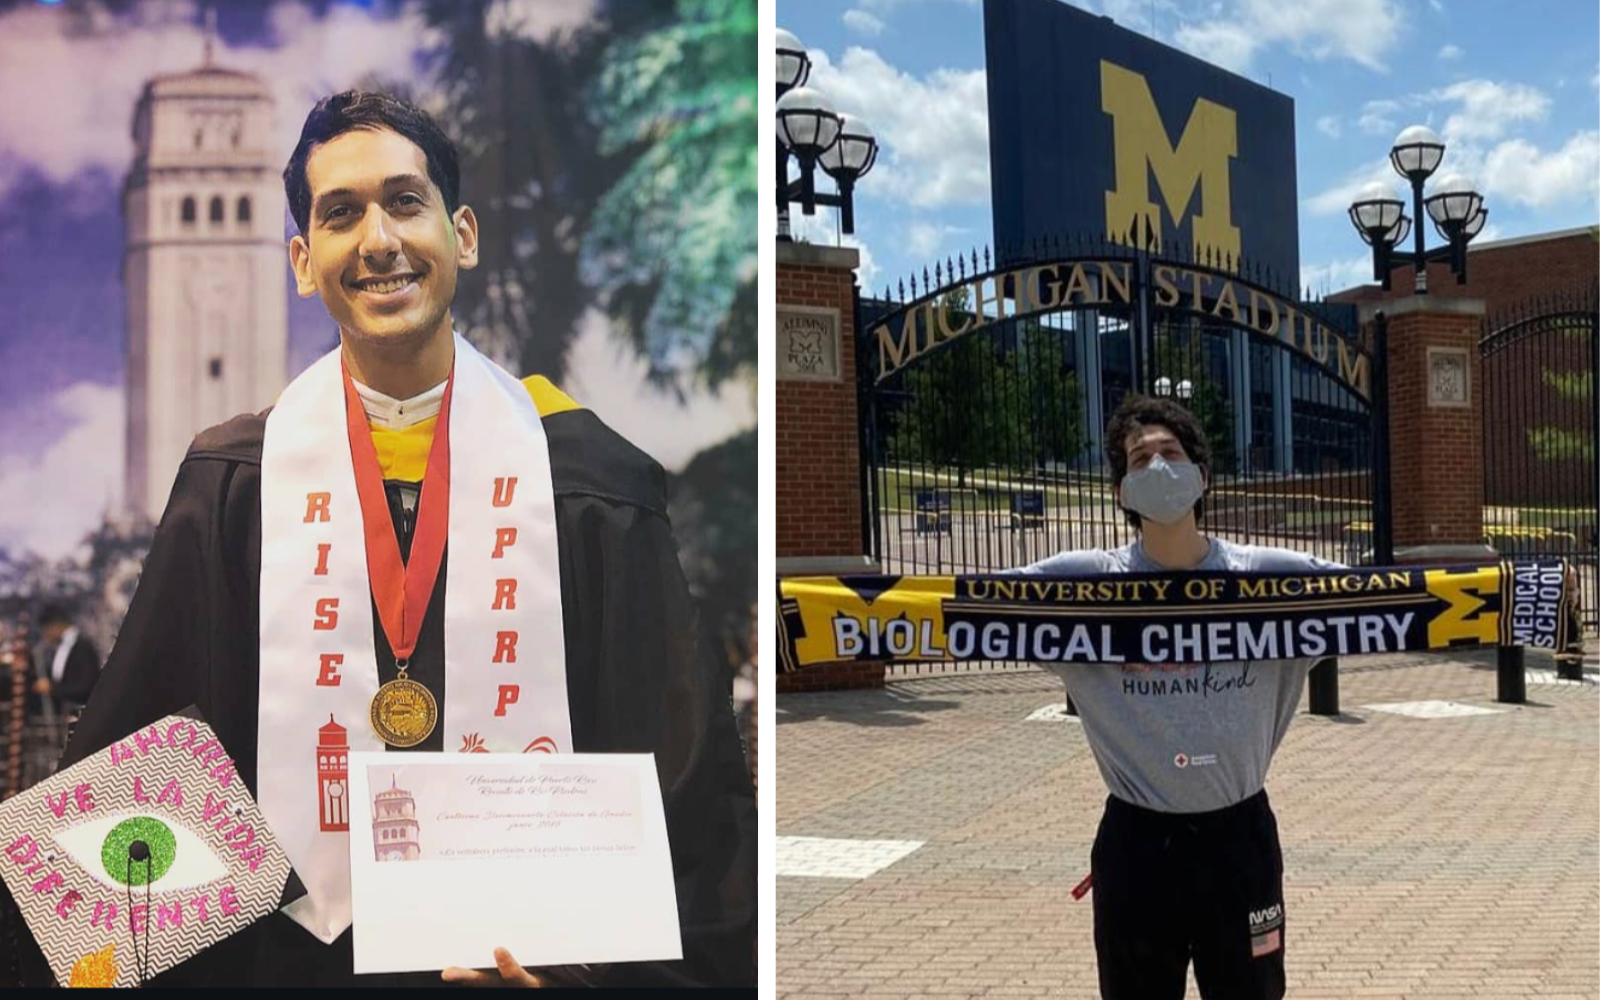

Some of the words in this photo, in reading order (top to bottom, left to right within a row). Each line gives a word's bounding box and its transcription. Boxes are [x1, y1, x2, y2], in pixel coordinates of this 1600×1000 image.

[1099, 58, 1242, 275] M
[873, 261, 1133, 386] MICHIGAN
[1153, 265, 1372, 404] STADIUM
[303, 491, 344, 686] RISE
[491, 477, 520, 717] UPRRP
[967, 580, 1172, 601] UNIVERSITY
[1184, 579, 1225, 599] OF
[1237, 571, 1412, 598] MICHIGAN
[1513, 562, 1538, 646] MEDICAL
[1534, 561, 1564, 648] SCHOOL
[833, 617, 1125, 662] BIOLOGICAL
[1141, 612, 1415, 663] CHEMISTRY
[110, 720, 235, 788] AHORA
[45, 783, 95, 818] VE
[133, 777, 182, 807] LA
[202, 793, 265, 872] VIDA
[5, 834, 240, 933] DIFERENTE
[1249, 903, 1282, 925] NASA
